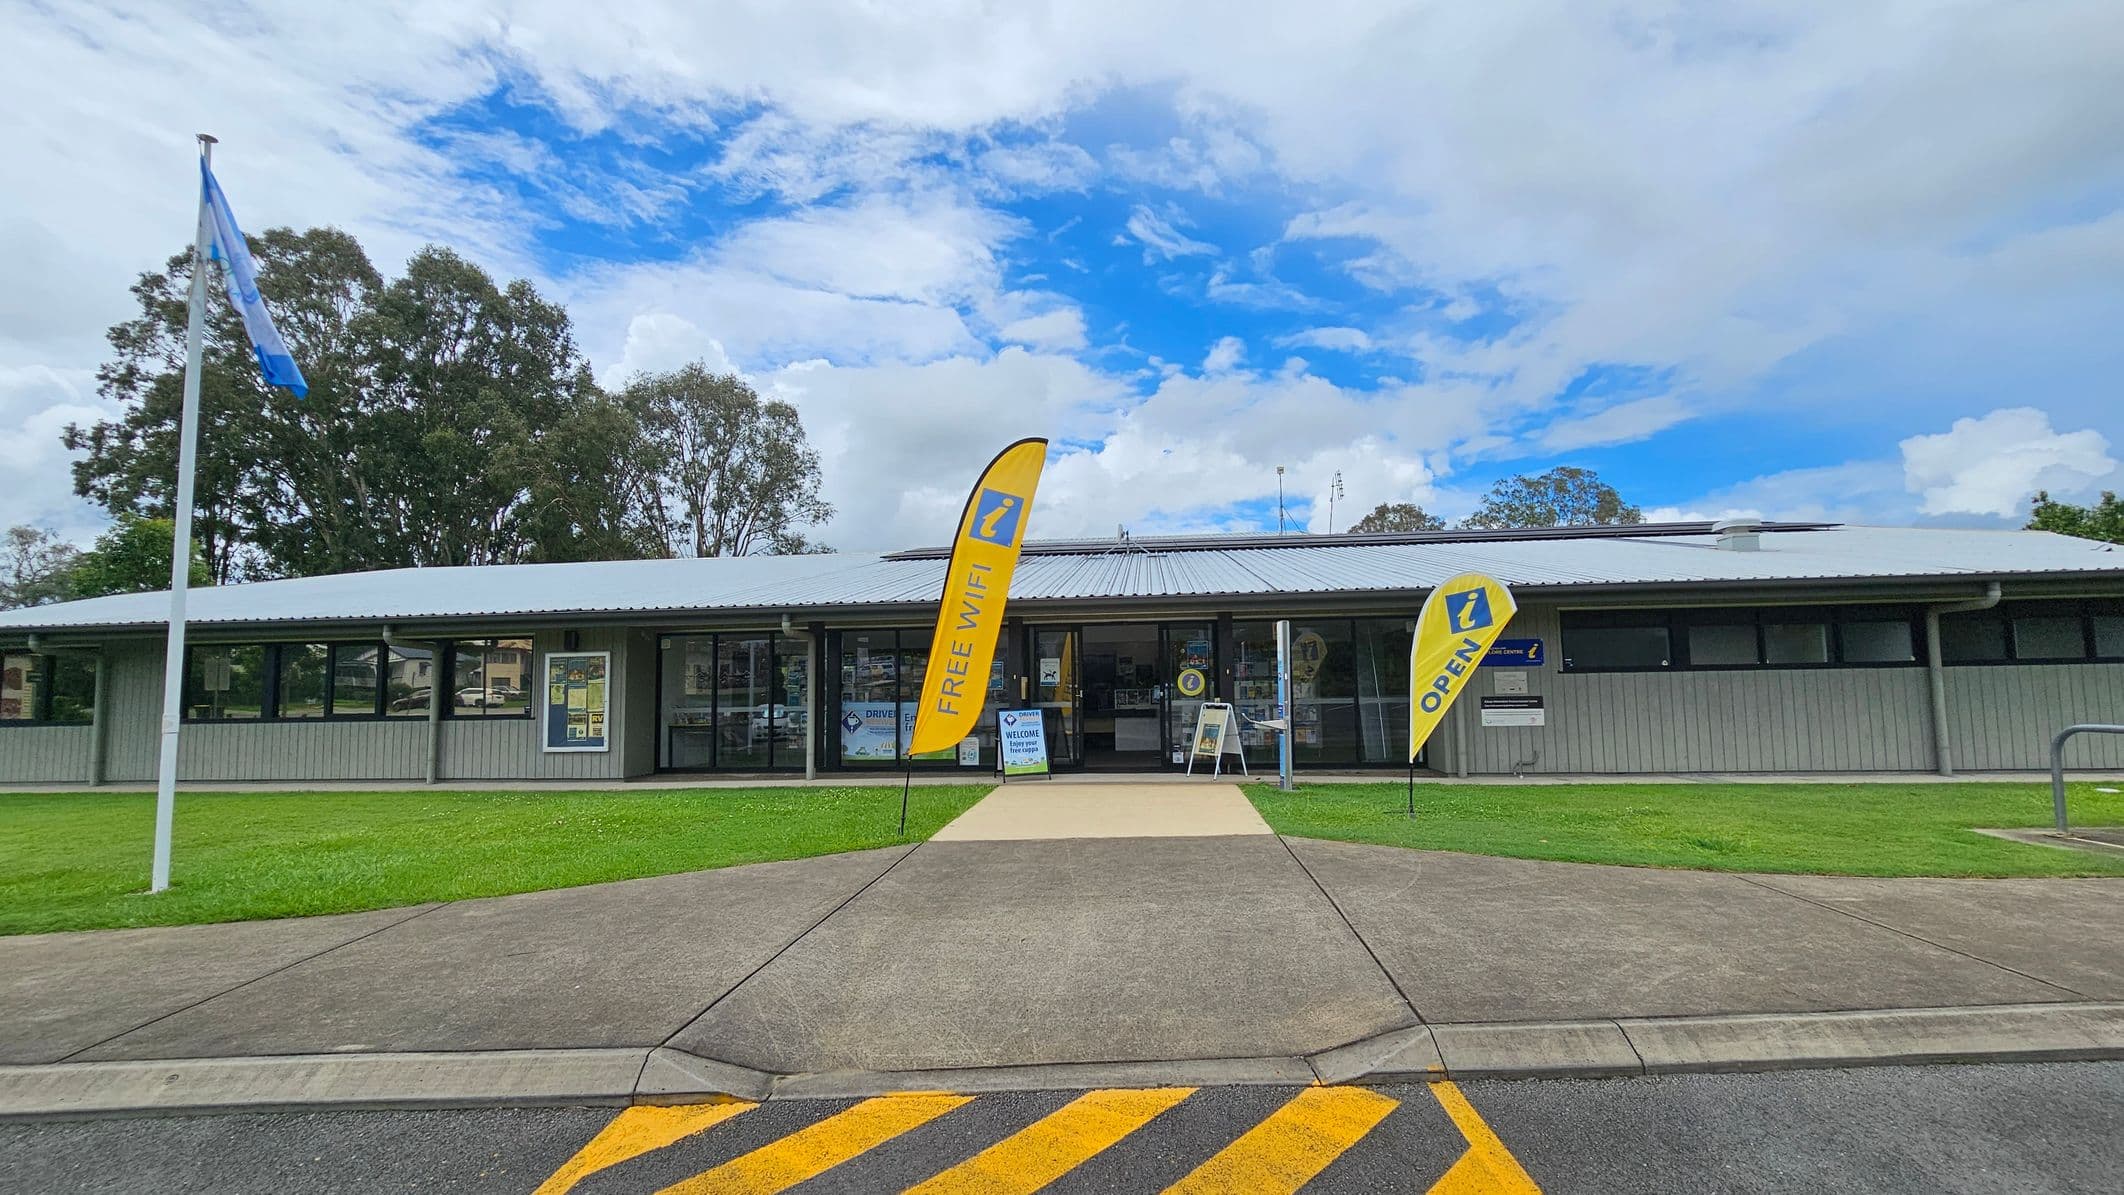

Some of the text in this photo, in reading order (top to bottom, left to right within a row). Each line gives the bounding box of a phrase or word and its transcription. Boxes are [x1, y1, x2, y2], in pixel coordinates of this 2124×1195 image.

[937, 640, 973, 716] FREE
[956, 563, 992, 632] WIFI
[1420, 637, 1482, 714] OPEN
[1005, 729, 1040, 739] WELCOME
[1009, 740, 1025, 748] Enjoy
[1021, 746, 1039, 754] cuppa
